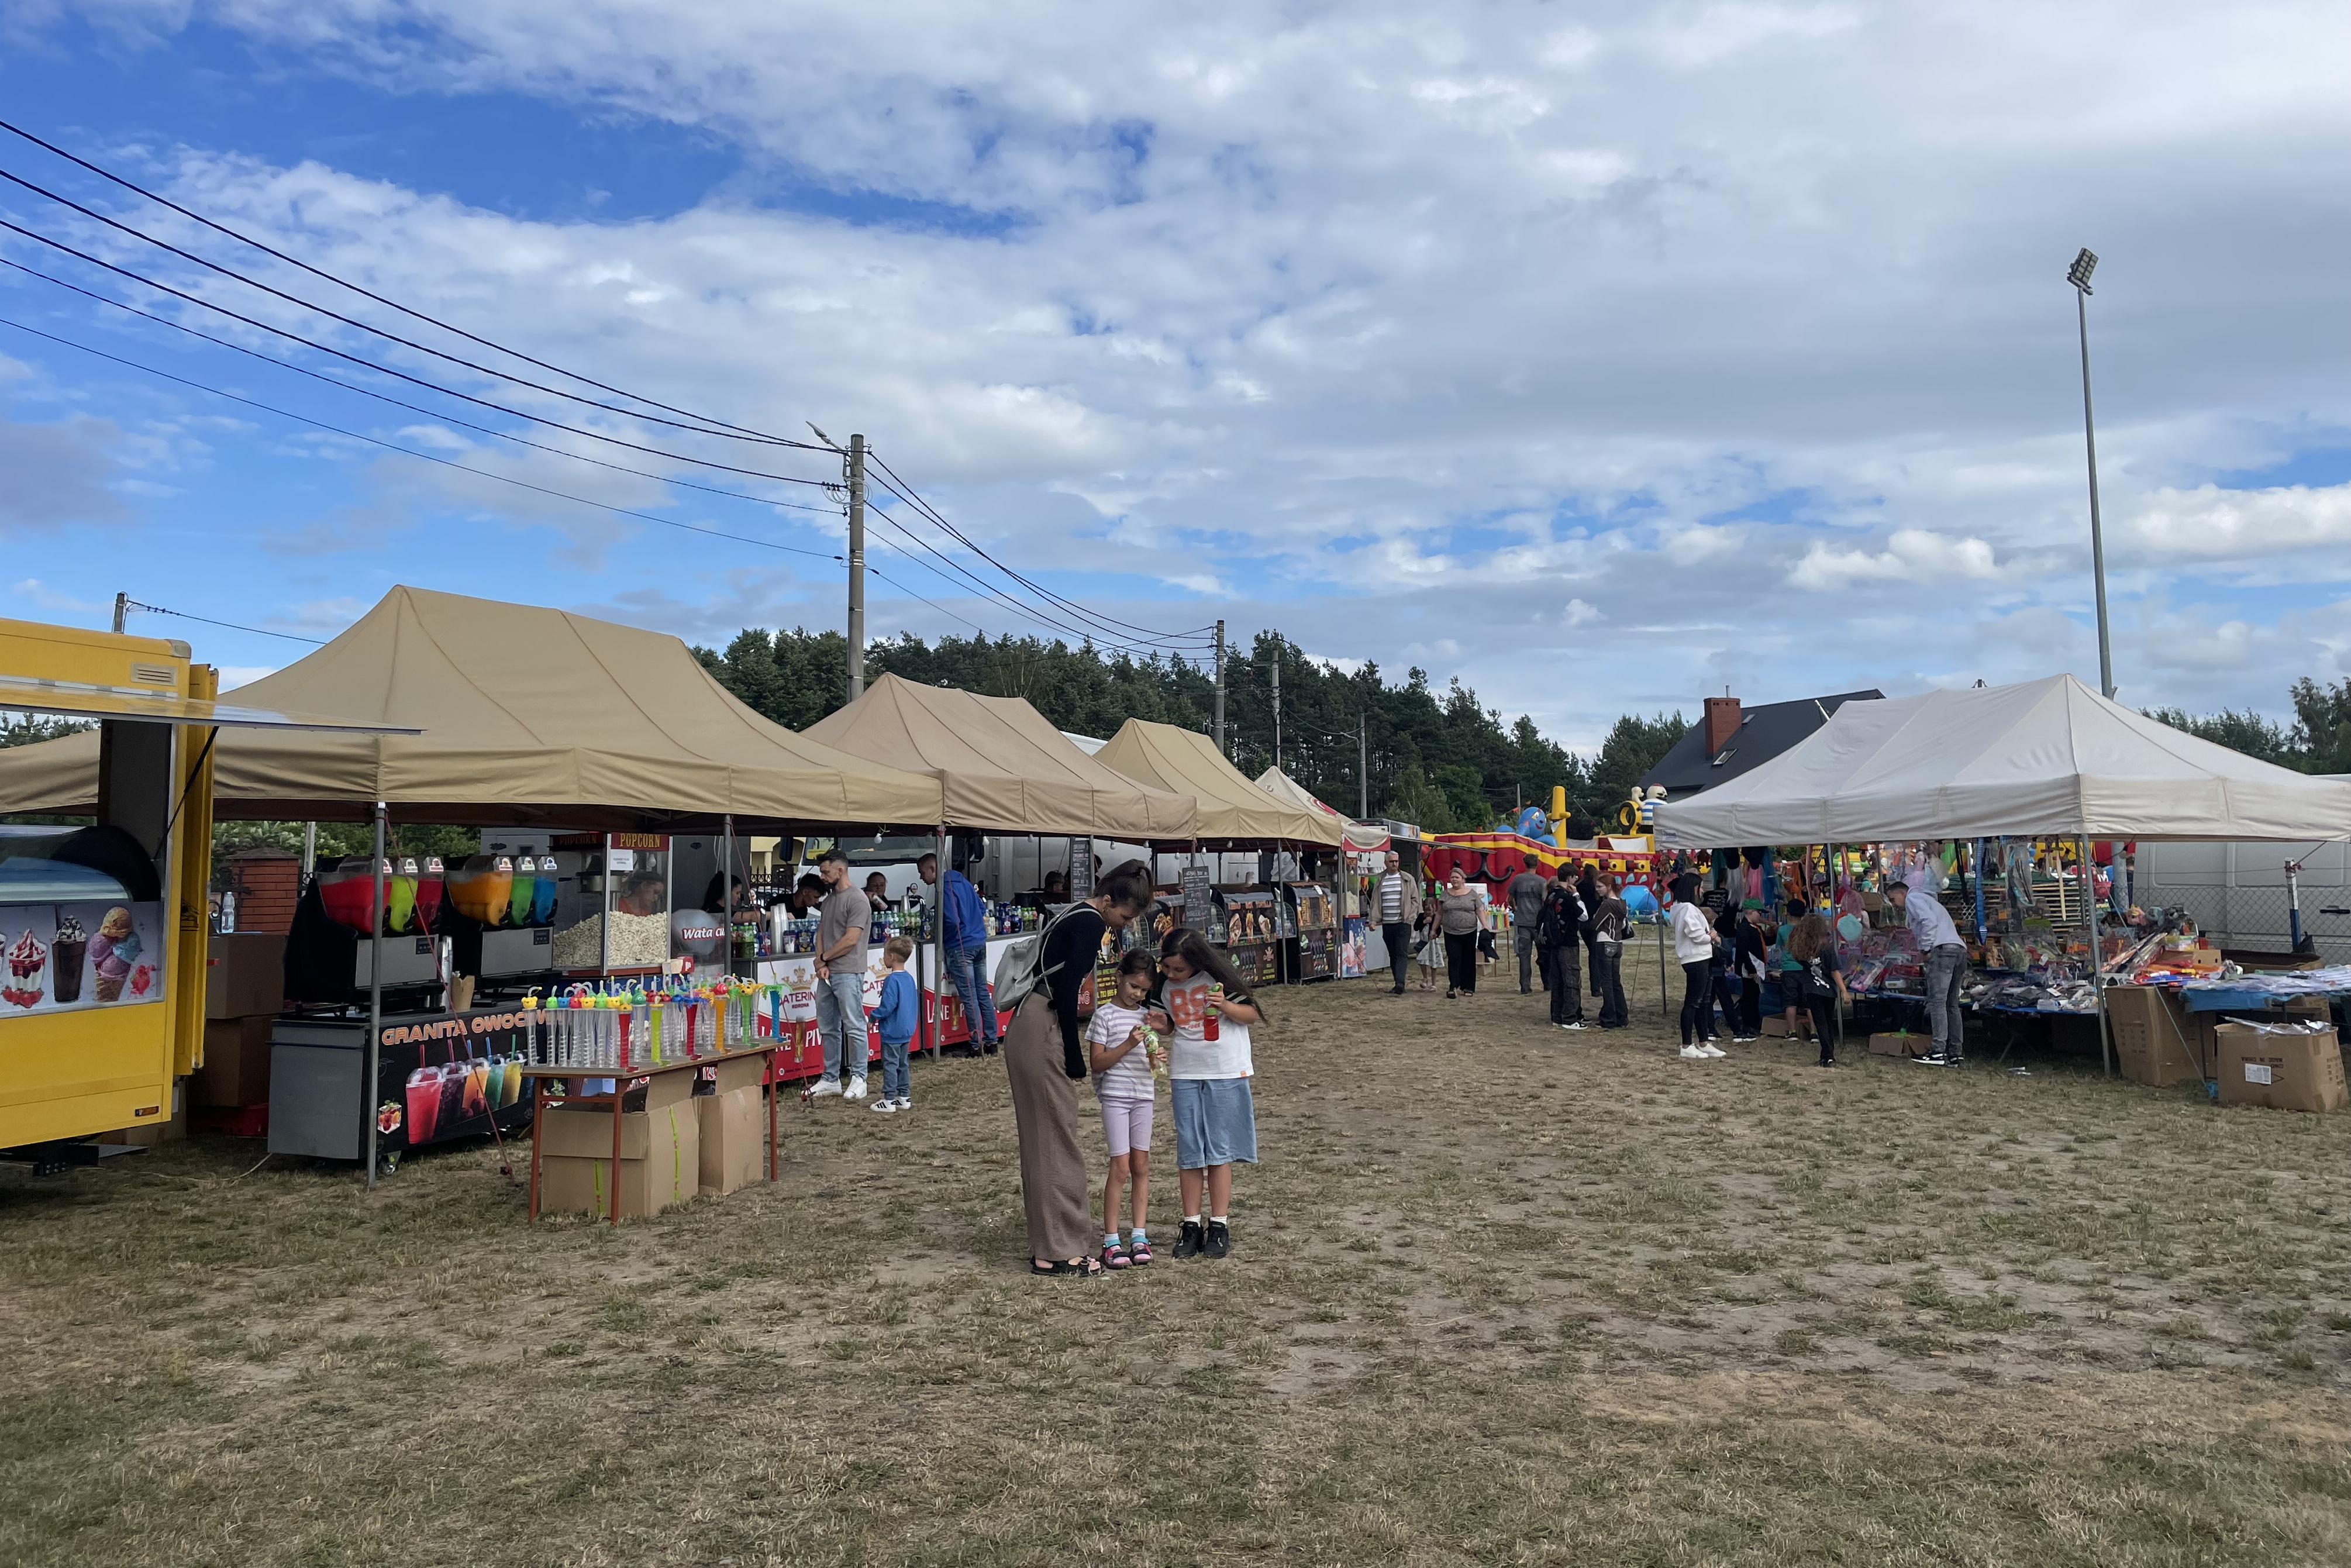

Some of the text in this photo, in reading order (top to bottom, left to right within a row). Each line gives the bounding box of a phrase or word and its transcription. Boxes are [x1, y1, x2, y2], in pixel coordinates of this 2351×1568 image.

[620, 833, 660, 848] POPCORN
[682, 927, 726, 940] Wata cu
[862, 980, 885, 994] CATE
[780, 990, 817, 1007] ATERIN
[382, 1019, 468, 1046] GRANITA
